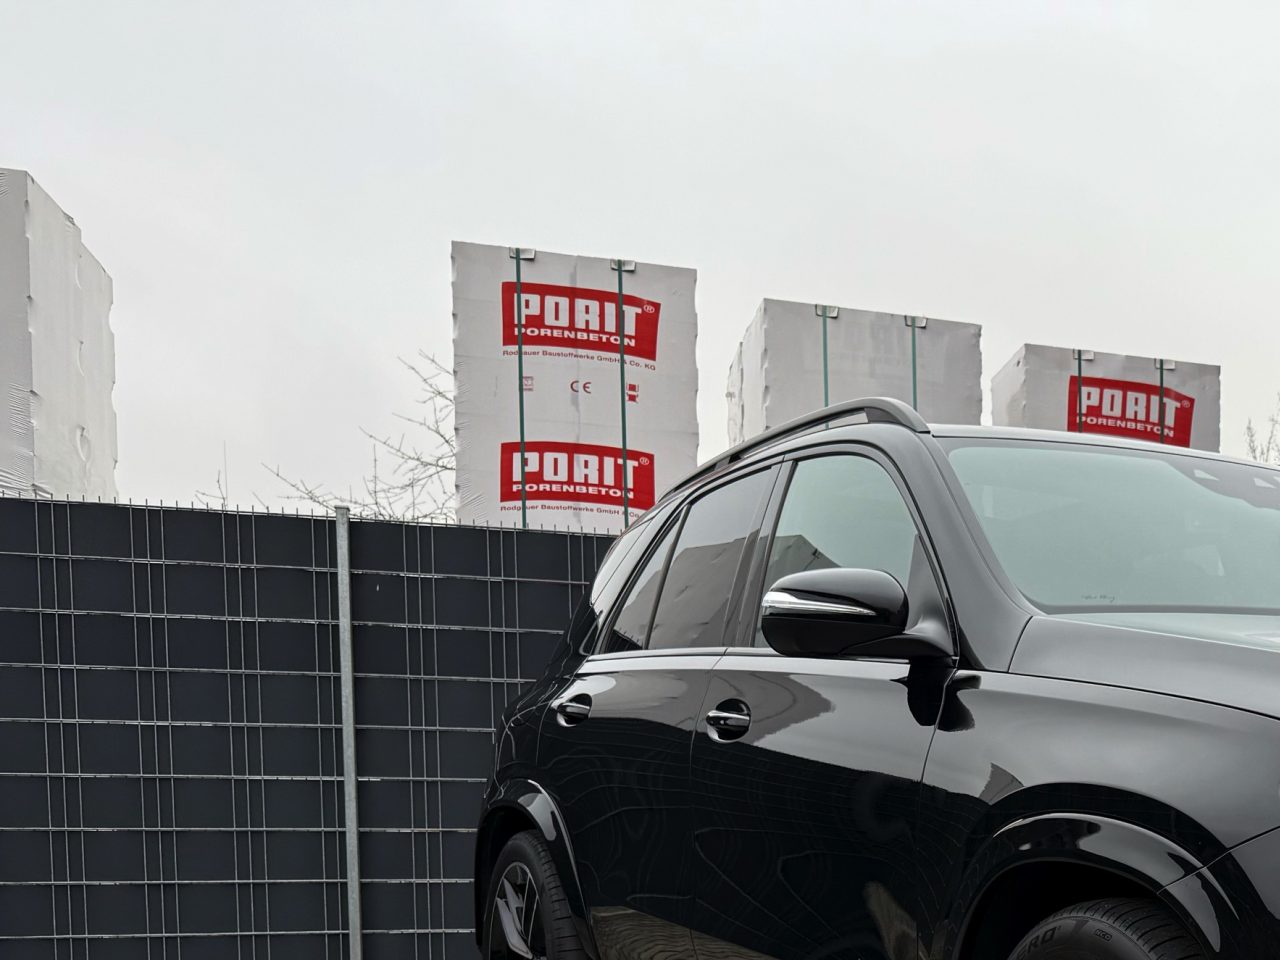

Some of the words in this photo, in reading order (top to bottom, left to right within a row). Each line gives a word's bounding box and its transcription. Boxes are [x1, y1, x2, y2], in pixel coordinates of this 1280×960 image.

[514, 327, 635, 347] PORENBETON
[1077, 416, 1174, 437] PORENBETON
[512, 483, 634, 499] PORENBETON
